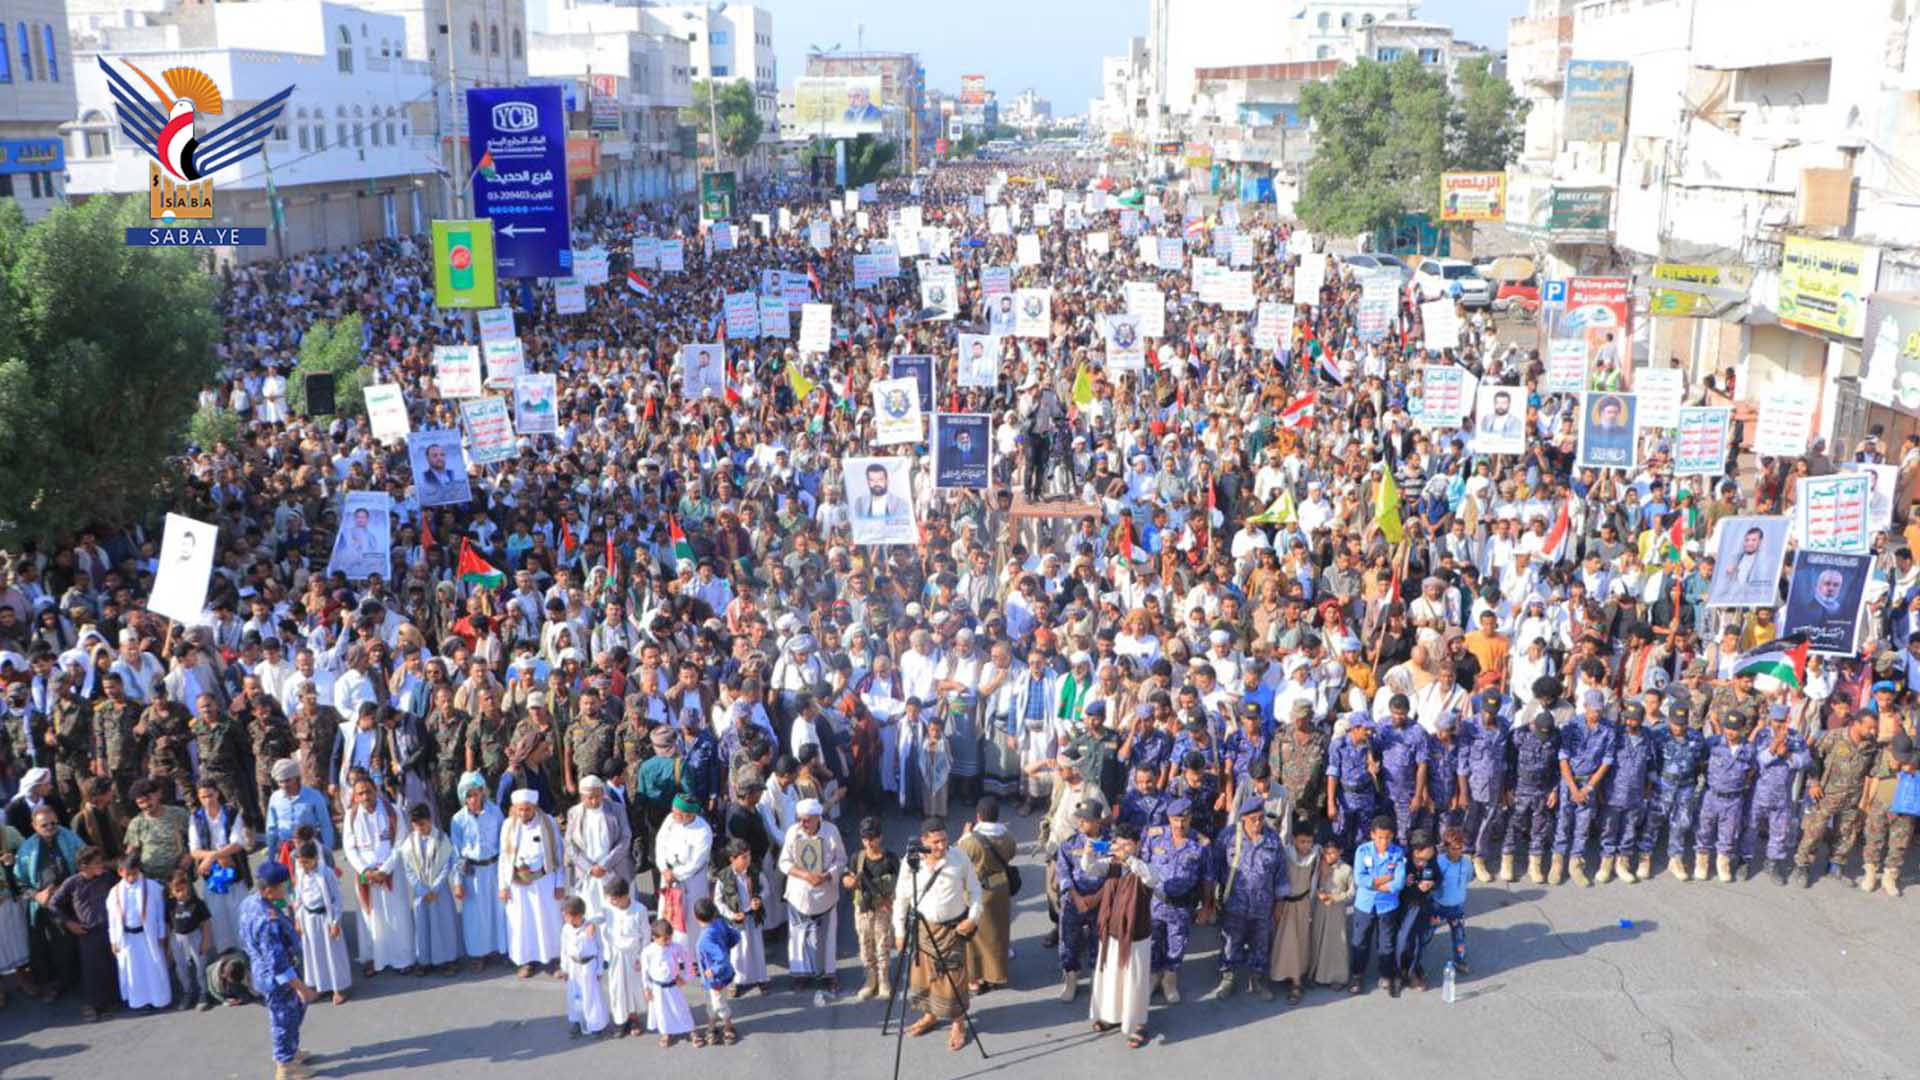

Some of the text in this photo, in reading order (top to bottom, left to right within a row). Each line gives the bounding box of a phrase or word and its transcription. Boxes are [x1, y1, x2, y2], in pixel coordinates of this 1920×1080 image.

[496, 106, 534, 128] YCB
[531, 169, 553, 185] فرع
[1547, 282, 1562, 300] P
